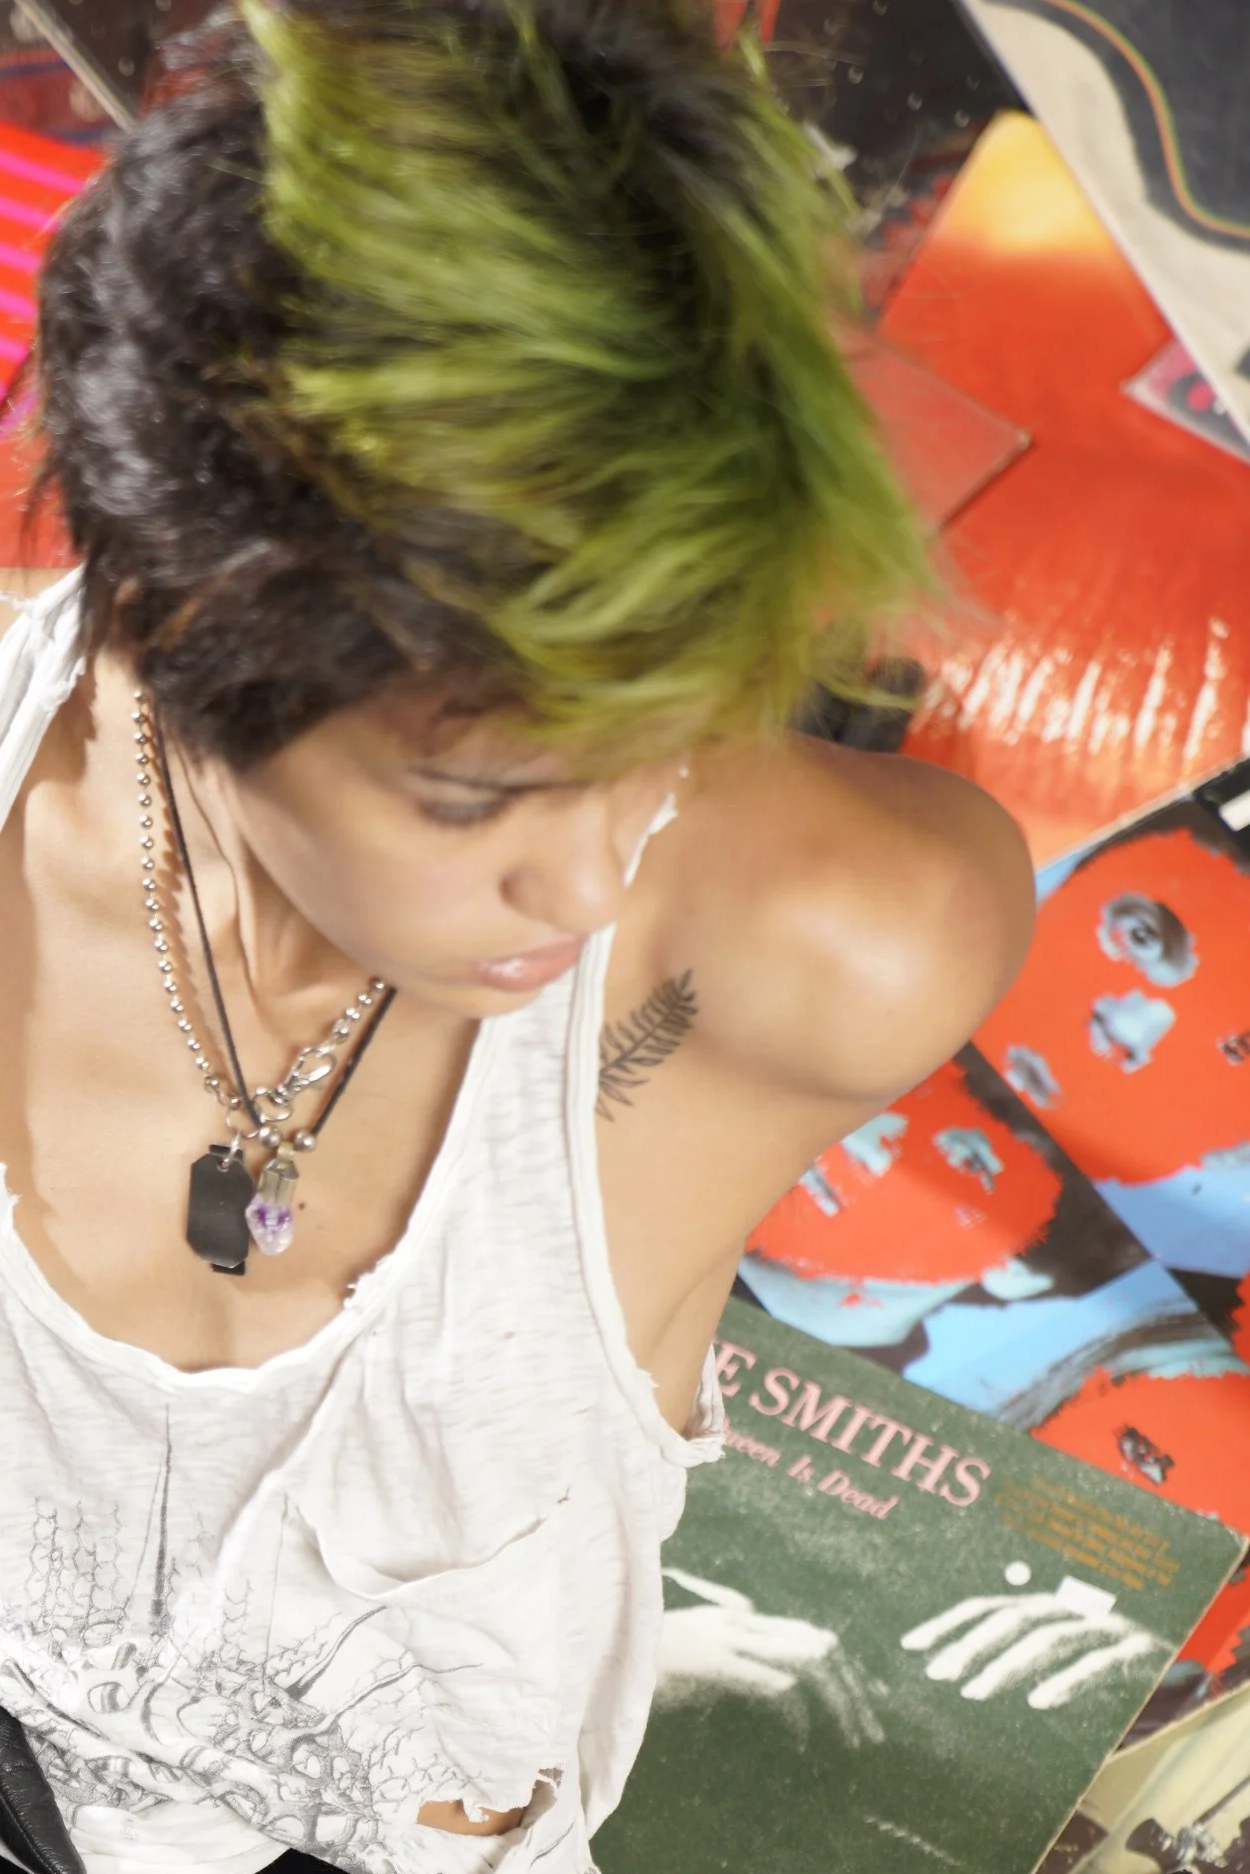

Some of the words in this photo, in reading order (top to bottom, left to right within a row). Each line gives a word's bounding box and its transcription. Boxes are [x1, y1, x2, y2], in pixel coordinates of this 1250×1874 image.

[751, 1368, 992, 1508] SMITHS
[789, 1454, 816, 1481] Is
[819, 1468, 899, 1519] Dead
